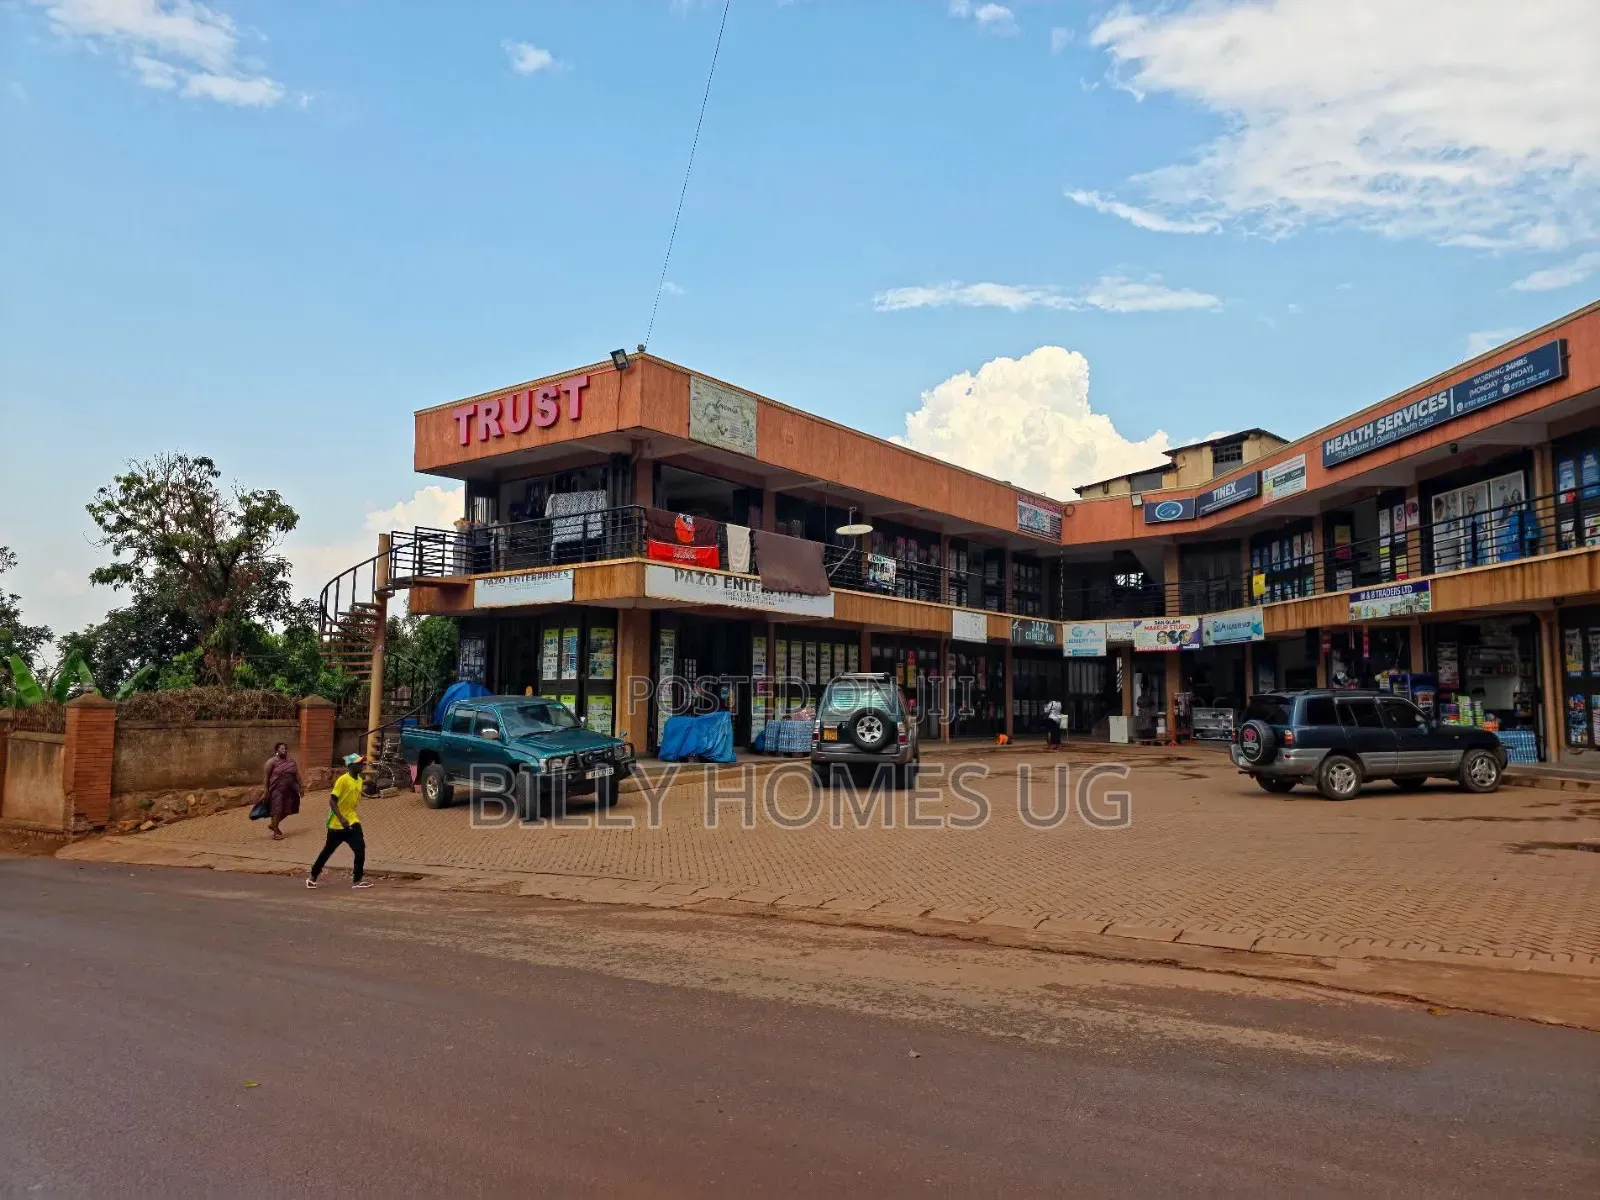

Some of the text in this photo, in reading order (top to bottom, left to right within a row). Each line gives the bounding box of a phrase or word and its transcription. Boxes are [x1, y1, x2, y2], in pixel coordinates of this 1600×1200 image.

[1473, 357, 1528, 385] WORKING 24HRS
[452, 375, 591, 446] TRUST
[1326, 391, 1448, 456] HEALTH SERVICES
[1376, 431, 1397, 444] Quality
[1397, 421, 1418, 435] Health
[1212, 481, 1237, 502] TINEX
[483, 577, 506, 586] PAZO
[508, 568, 569, 584] ENTERPRISES
[673, 567, 718, 587] PAZO
[1375, 586, 1401, 598] TRADERS
[1401, 584, 1413, 594] LTD
[1031, 621, 1049, 634] JAZZ
